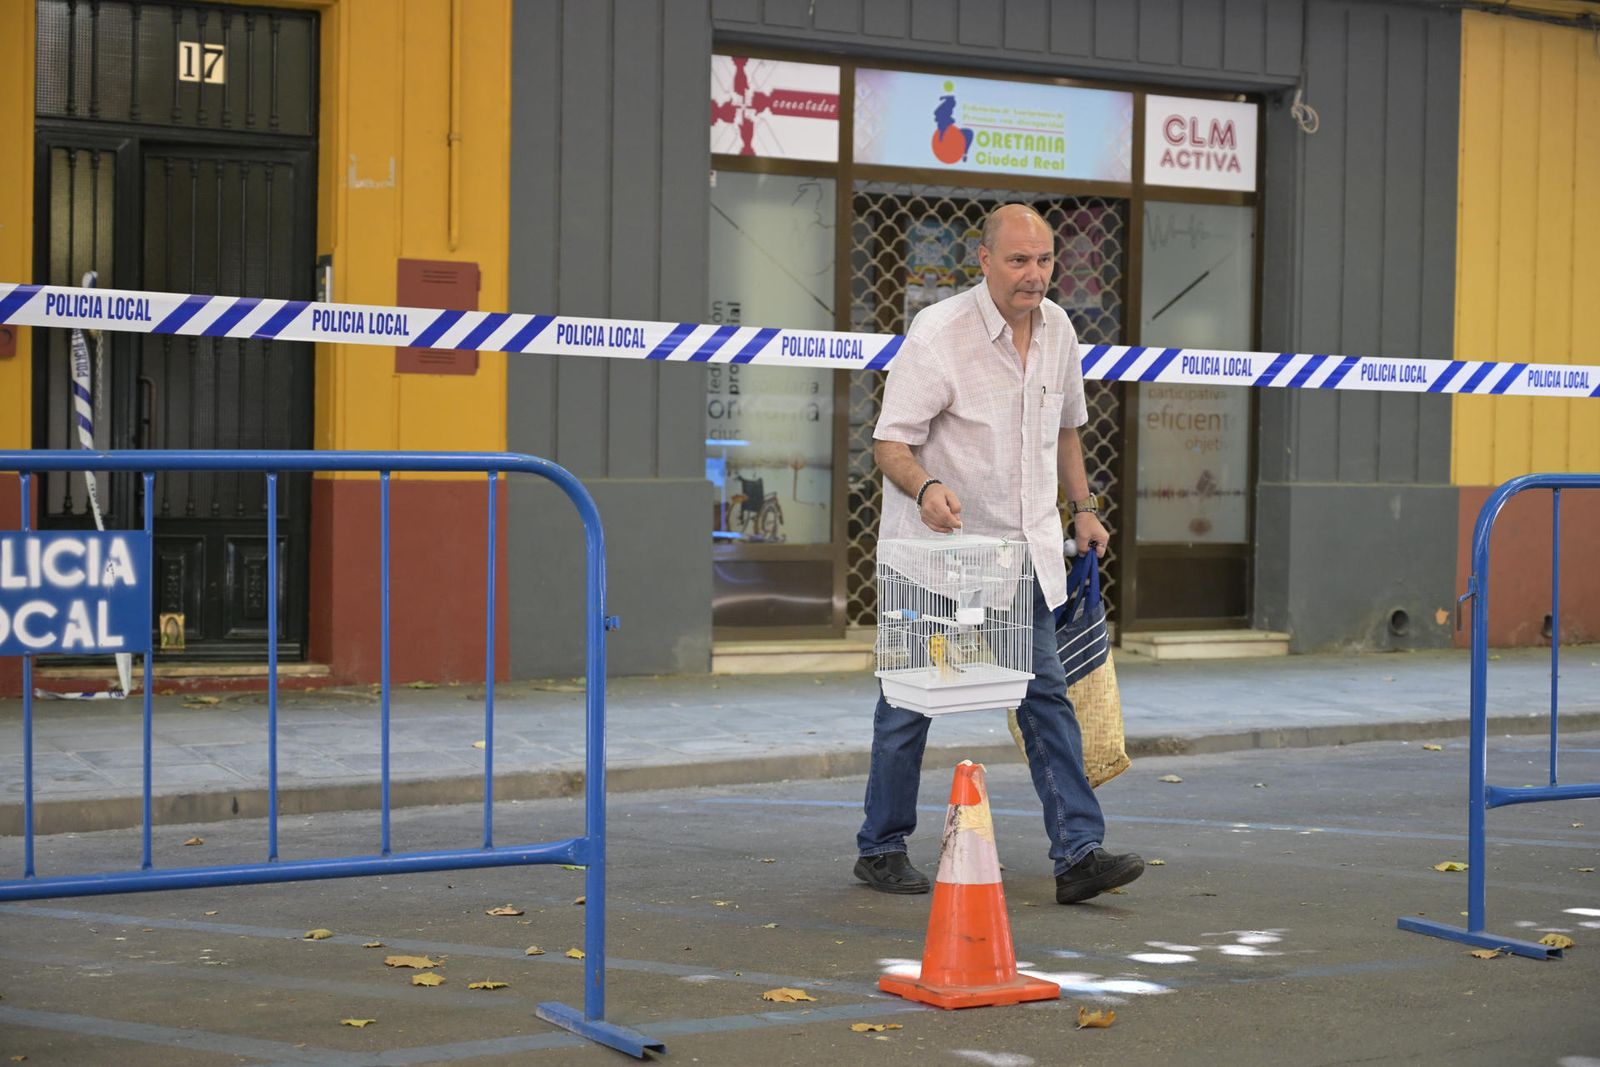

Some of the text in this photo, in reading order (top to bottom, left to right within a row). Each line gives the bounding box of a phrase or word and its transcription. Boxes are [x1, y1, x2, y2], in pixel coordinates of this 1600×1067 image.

[183, 45, 224, 79] 17
[975, 130, 1065, 154] ORETANIA
[1163, 114, 1237, 150] CLM
[975, 151, 1065, 170] Ciudad Real
[1160, 149, 1241, 173] ACTIVA
[45, 292, 152, 321] POLICIA LOCAL
[312, 309, 409, 336] POLICIA LOCAL
[556, 323, 646, 349] POLICIA LOCAL
[781, 336, 864, 360] POLICIA LOCAL
[1181, 355, 1253, 377] POLICIA LOCAL
[1361, 363, 1427, 383] POLICIA LOCAL
[1528, 370, 1590, 389] POLICIA LOCAL
[0, 537, 136, 588] LICIA
[0, 599, 124, 648] CAL
